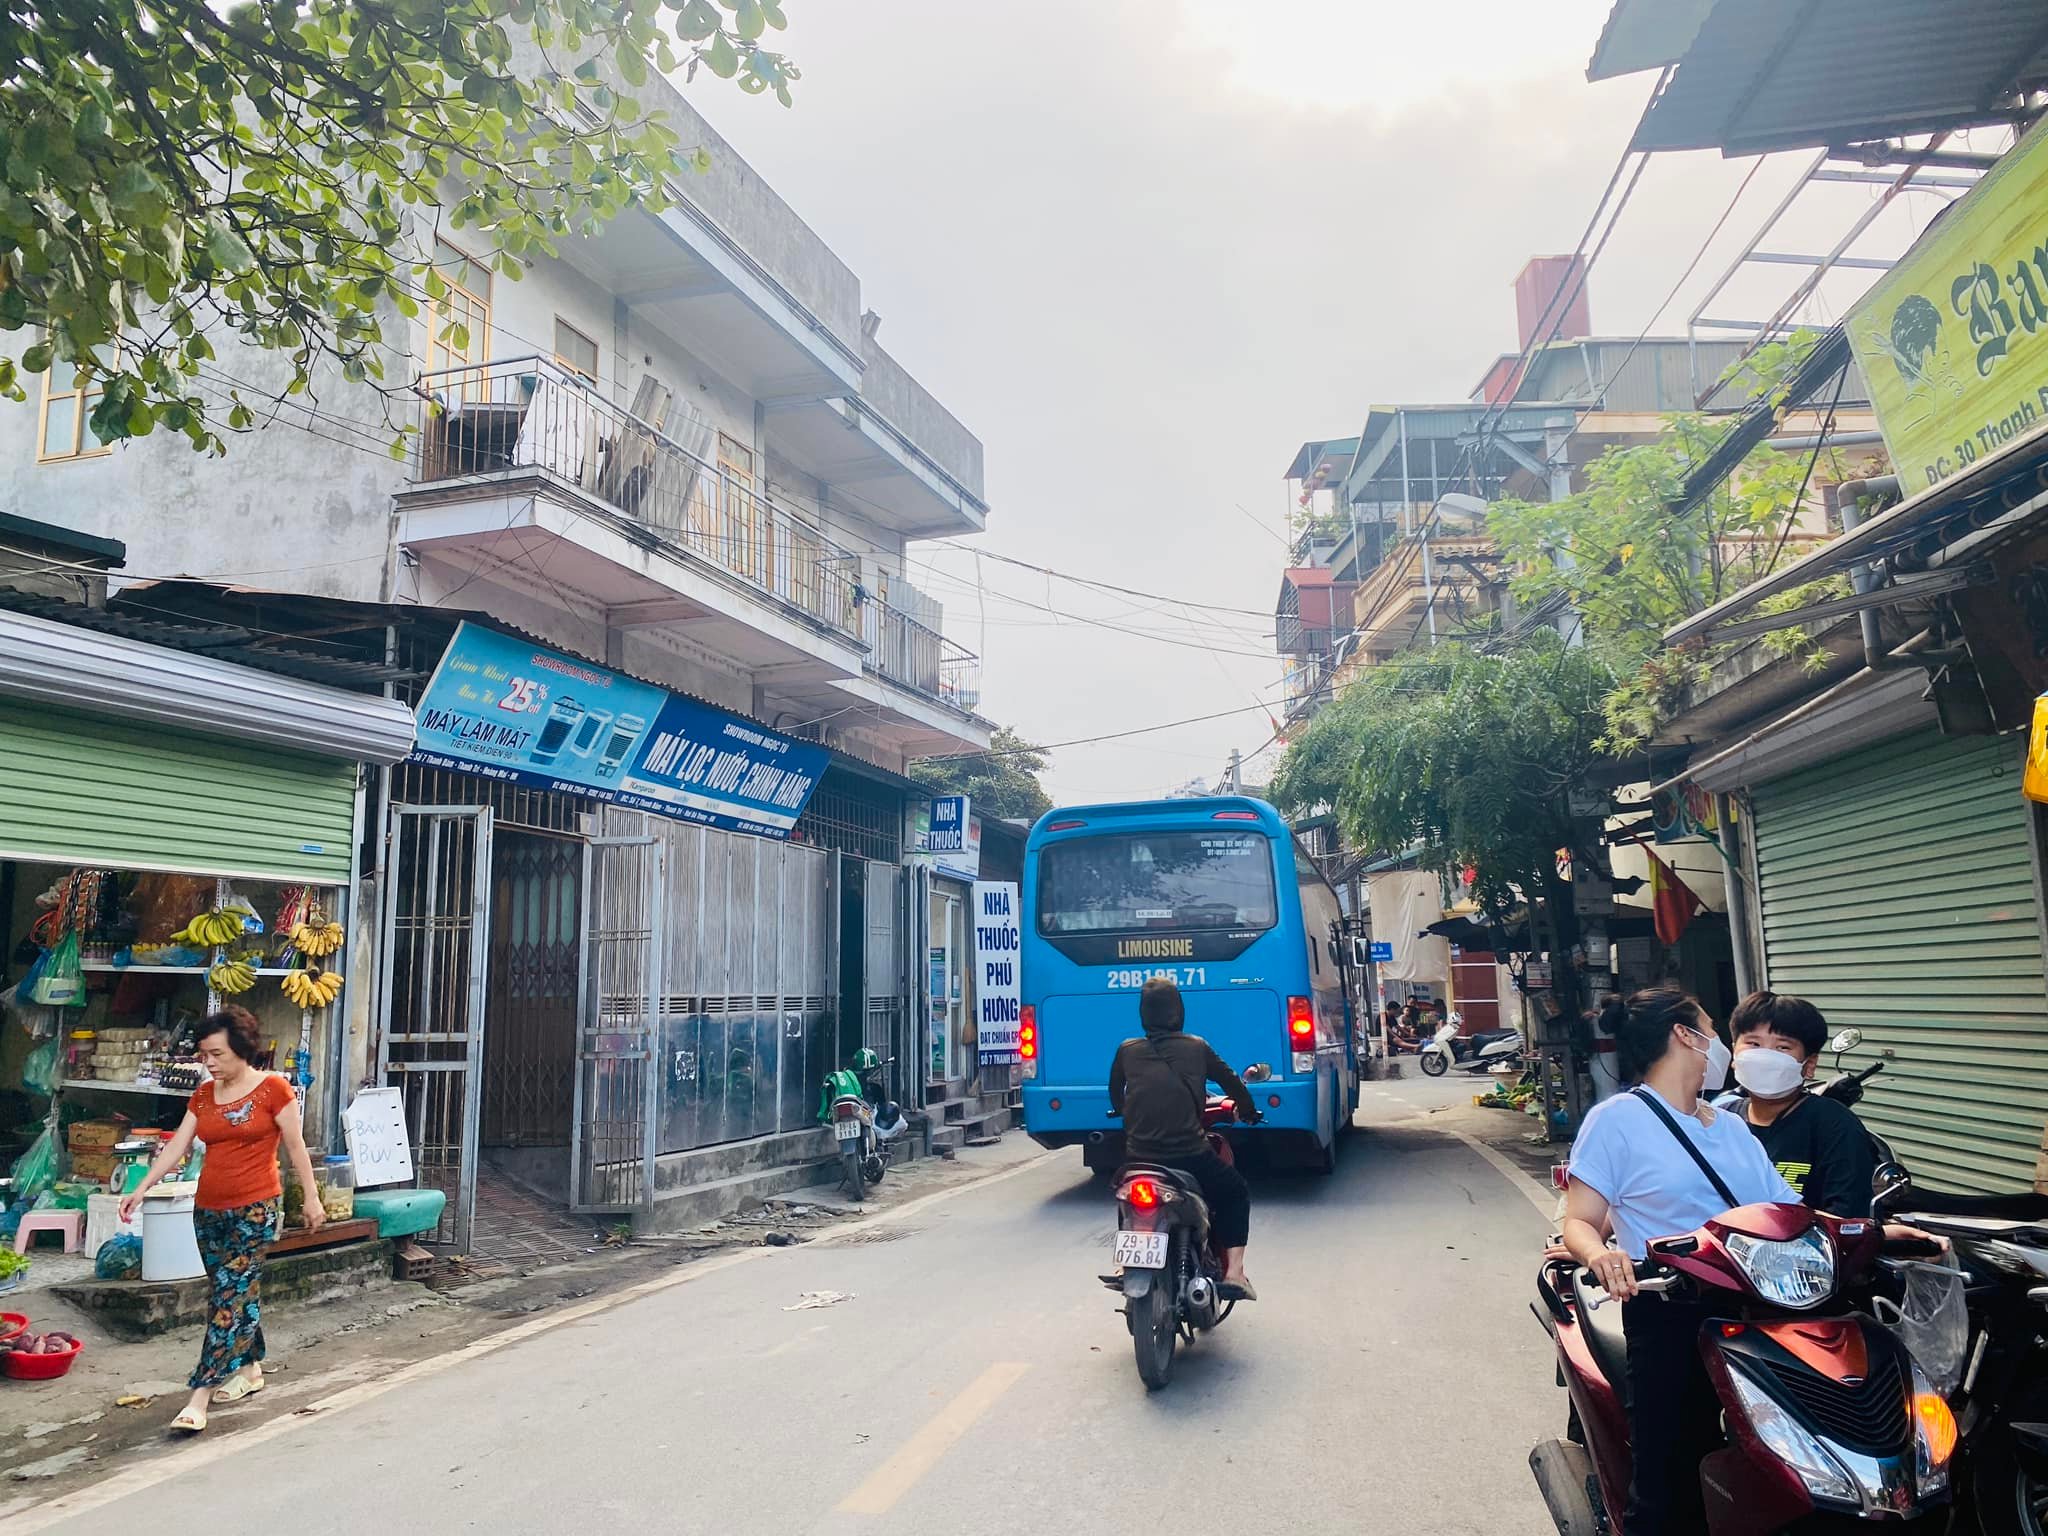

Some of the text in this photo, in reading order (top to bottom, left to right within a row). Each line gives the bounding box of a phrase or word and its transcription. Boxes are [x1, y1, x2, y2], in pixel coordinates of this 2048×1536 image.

[1955, 439, 1976, 468] 30
[1975, 400, 2036, 452] Thanh
[531, 653, 578, 678] SHOWROOM
[422, 708, 531, 750] MÁY LÀM MÁT
[723, 723, 765, 746] SHOWROOM
[642, 729, 812, 810] MÁY LỌC NƯỚC CHÍNH HÃNG
[935, 798, 957, 822] NHÀ
[930, 823, 961, 850] THUỐC
[984, 887, 1010, 916] NHÀ
[977, 919, 1018, 951] THUỐC
[1117, 938, 1194, 958] LIMOUSINE
[986, 957, 1012, 986] PHÚ
[982, 995, 1018, 1023] HƯNG
[980, 1031, 991, 1047] ĐẠT
[993, 1053, 1010, 1065] THANH
[1115, 1249, 1162, 1265] 076.84
